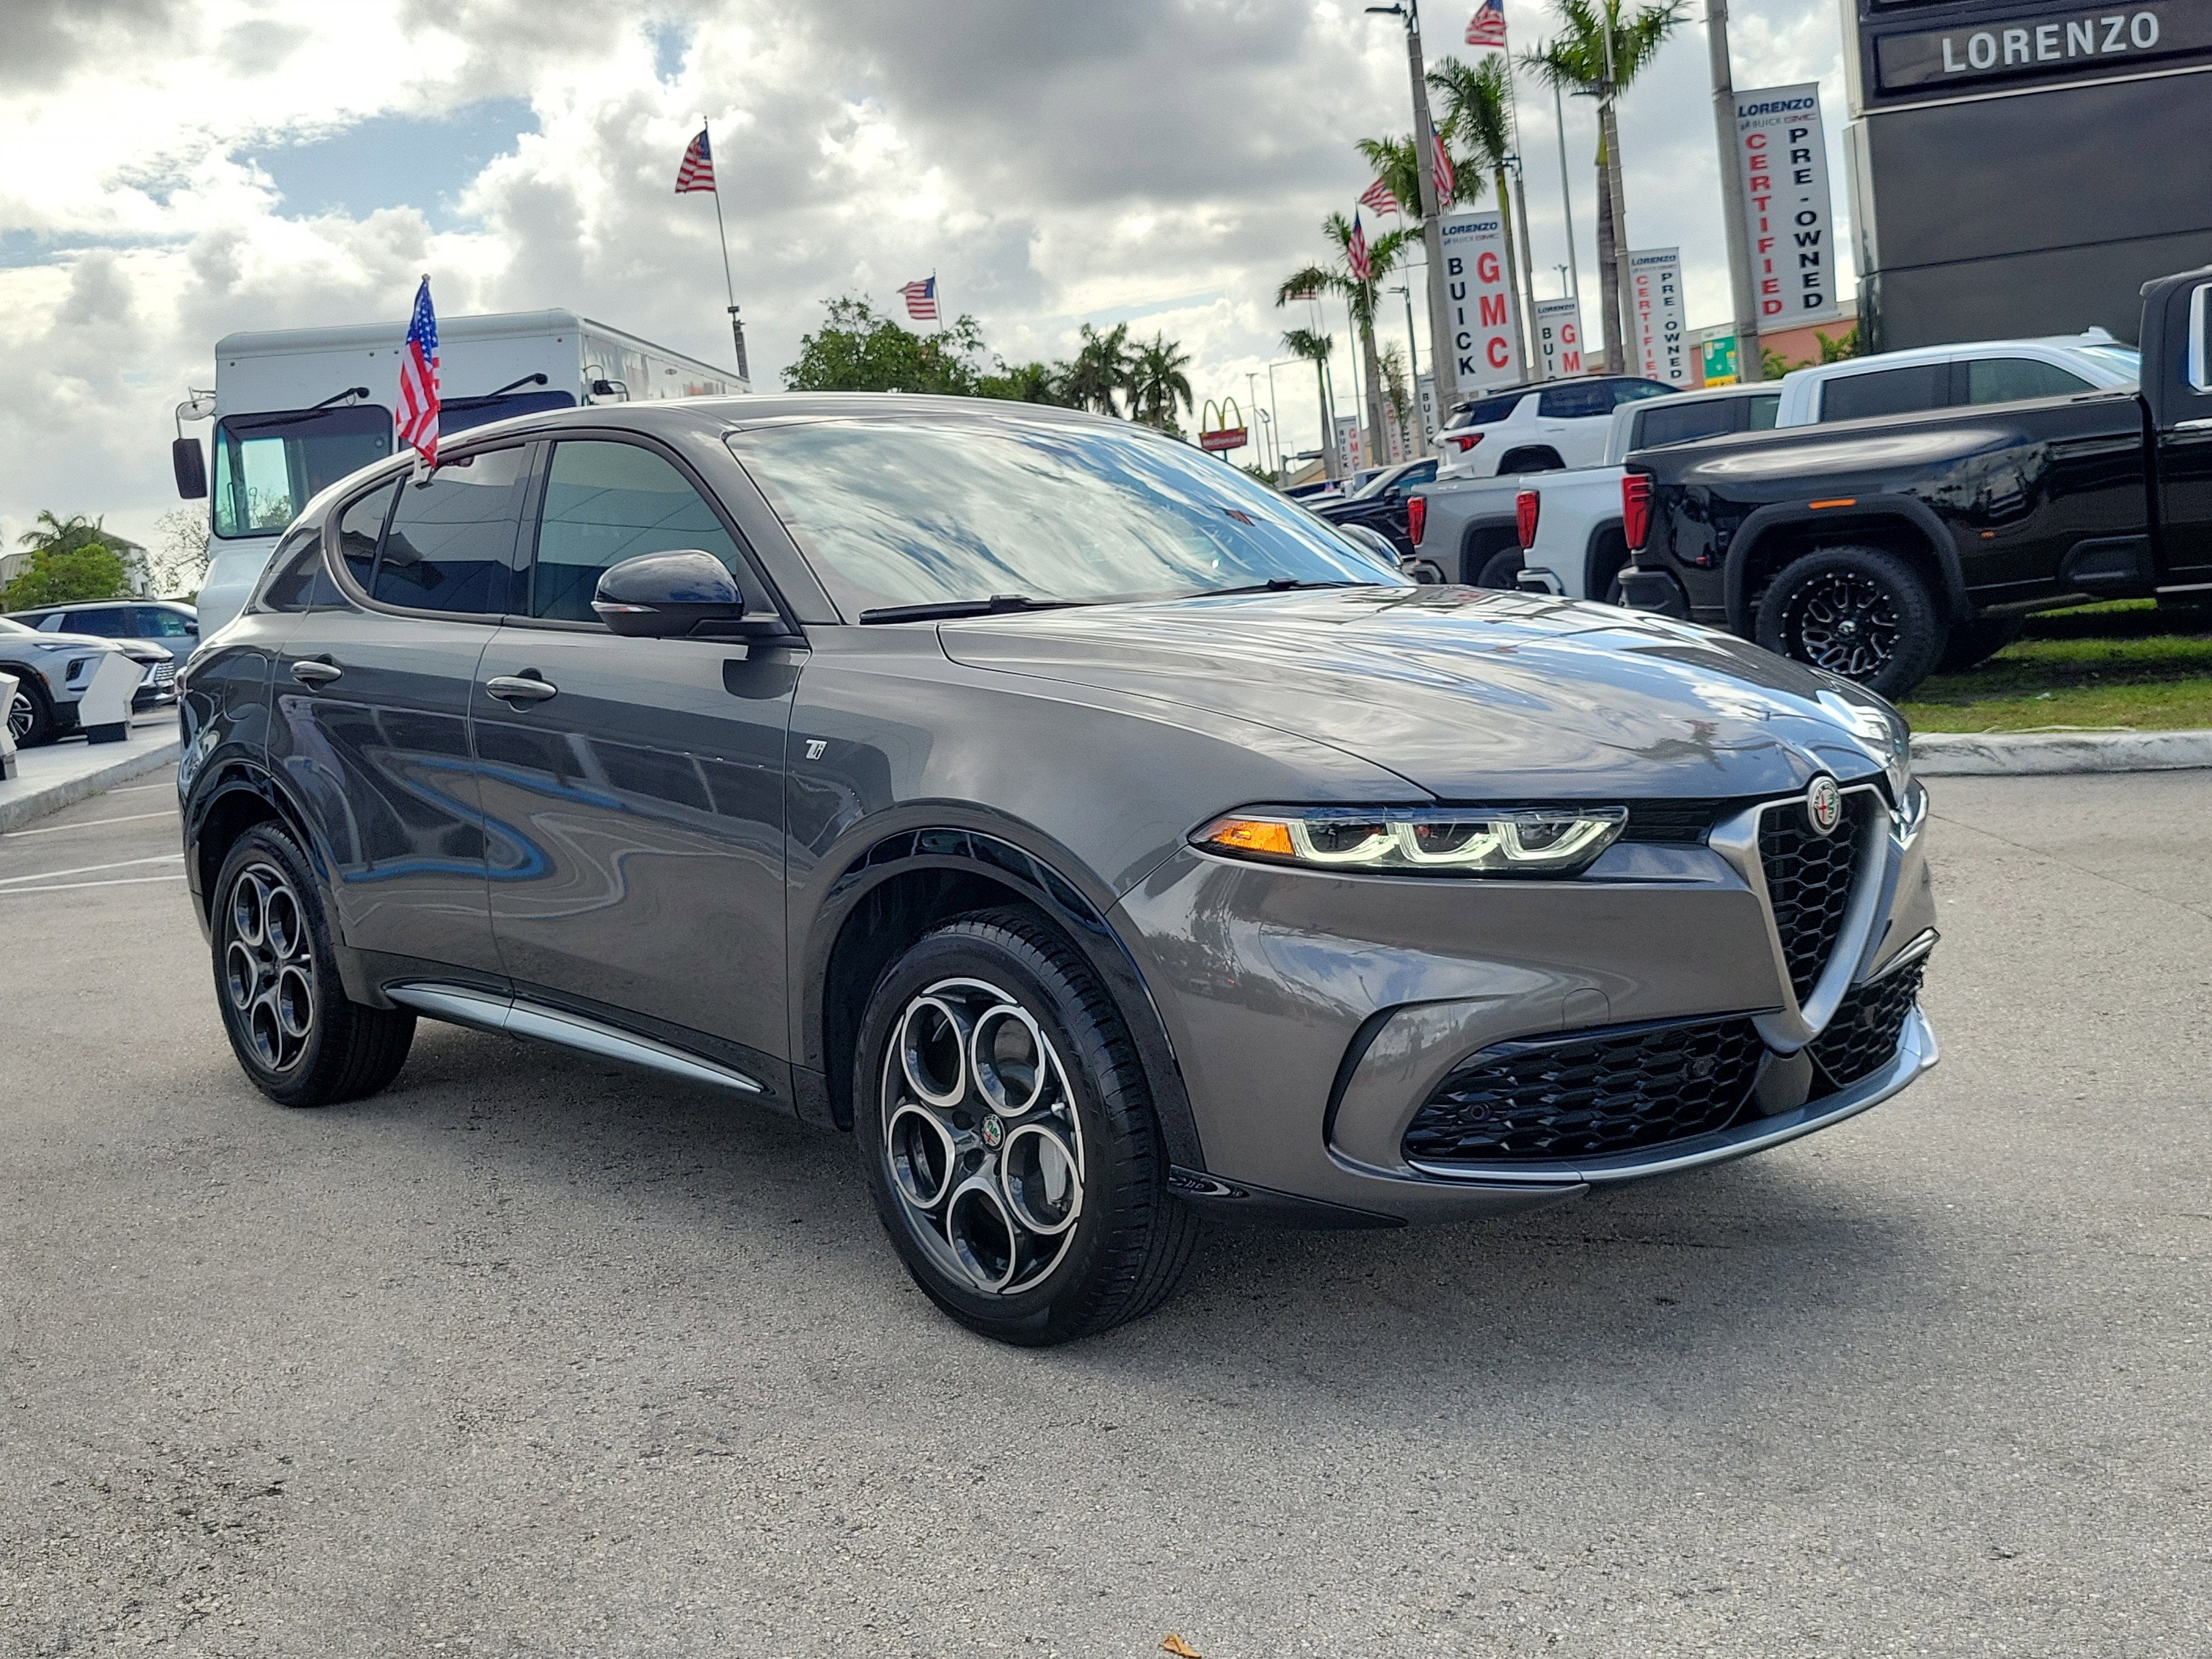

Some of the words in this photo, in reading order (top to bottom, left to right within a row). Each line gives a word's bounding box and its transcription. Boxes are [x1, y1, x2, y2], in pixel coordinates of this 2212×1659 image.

[1942, 11, 2160, 73] LORENZO
[1738, 97, 1814, 117] LORENZO
[1442, 222, 1498, 236] LORENZO
[1745, 133, 1783, 317] CERTIFIED
[1632, 255, 1677, 266] LORENZO
[1447, 257, 1476, 376] BUICK
[1476, 251, 1509, 369] GMC
[1422, 393, 1434, 445] BUICK
